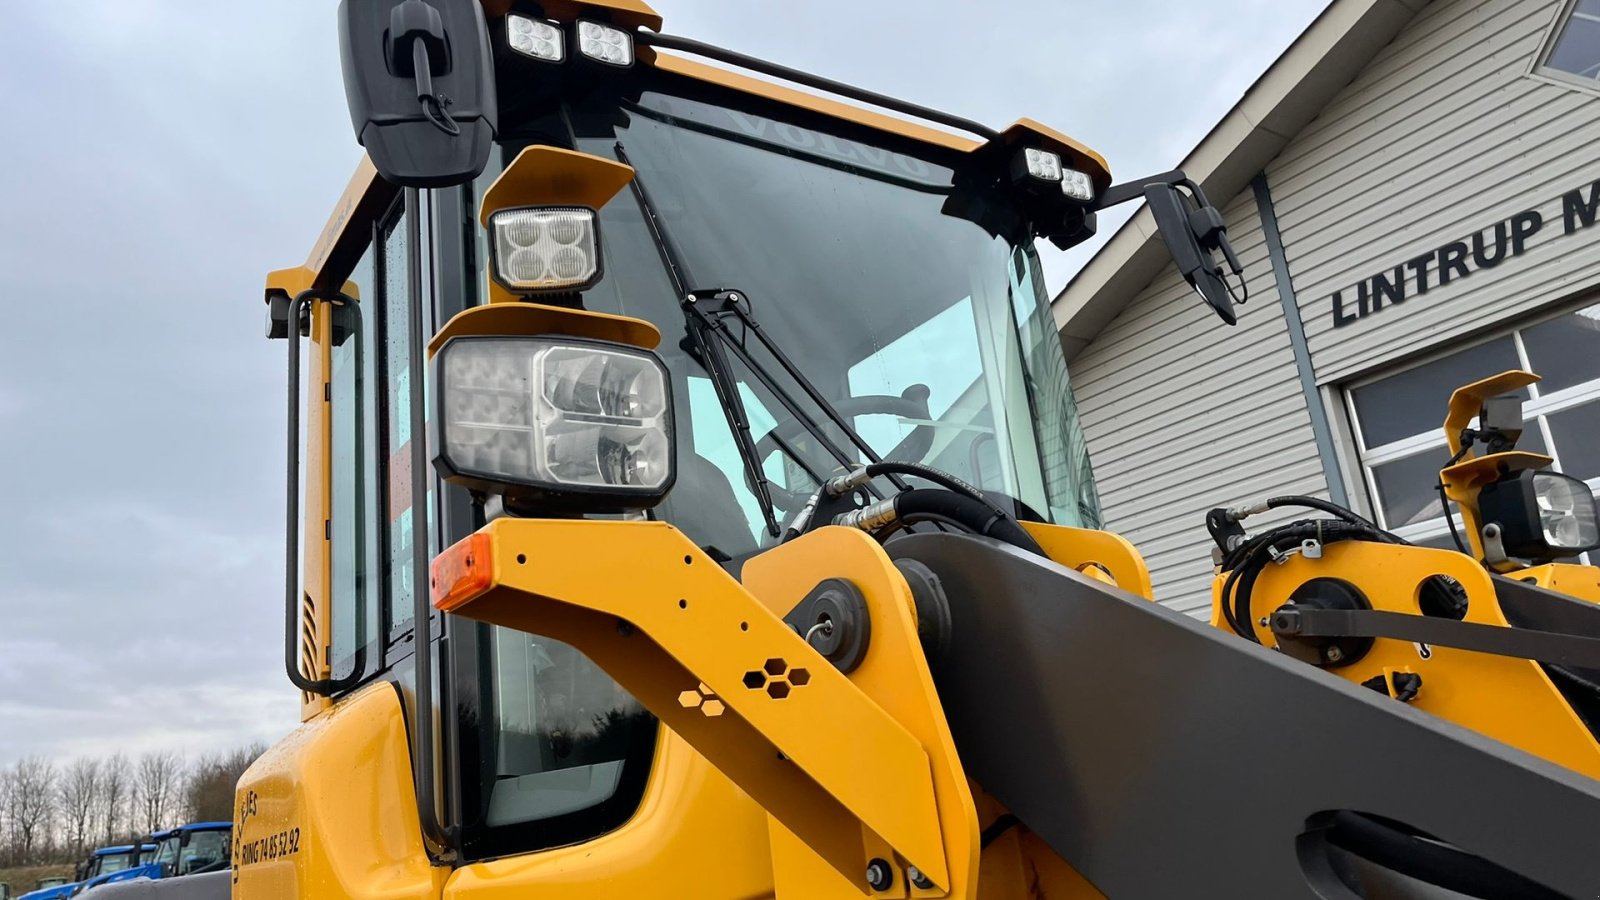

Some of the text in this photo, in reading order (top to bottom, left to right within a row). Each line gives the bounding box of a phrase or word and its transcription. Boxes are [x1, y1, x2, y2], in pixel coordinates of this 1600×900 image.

[1332, 211, 1542, 328] LINTRUP
[242, 827, 300, 865] RING 74 85 52 92
